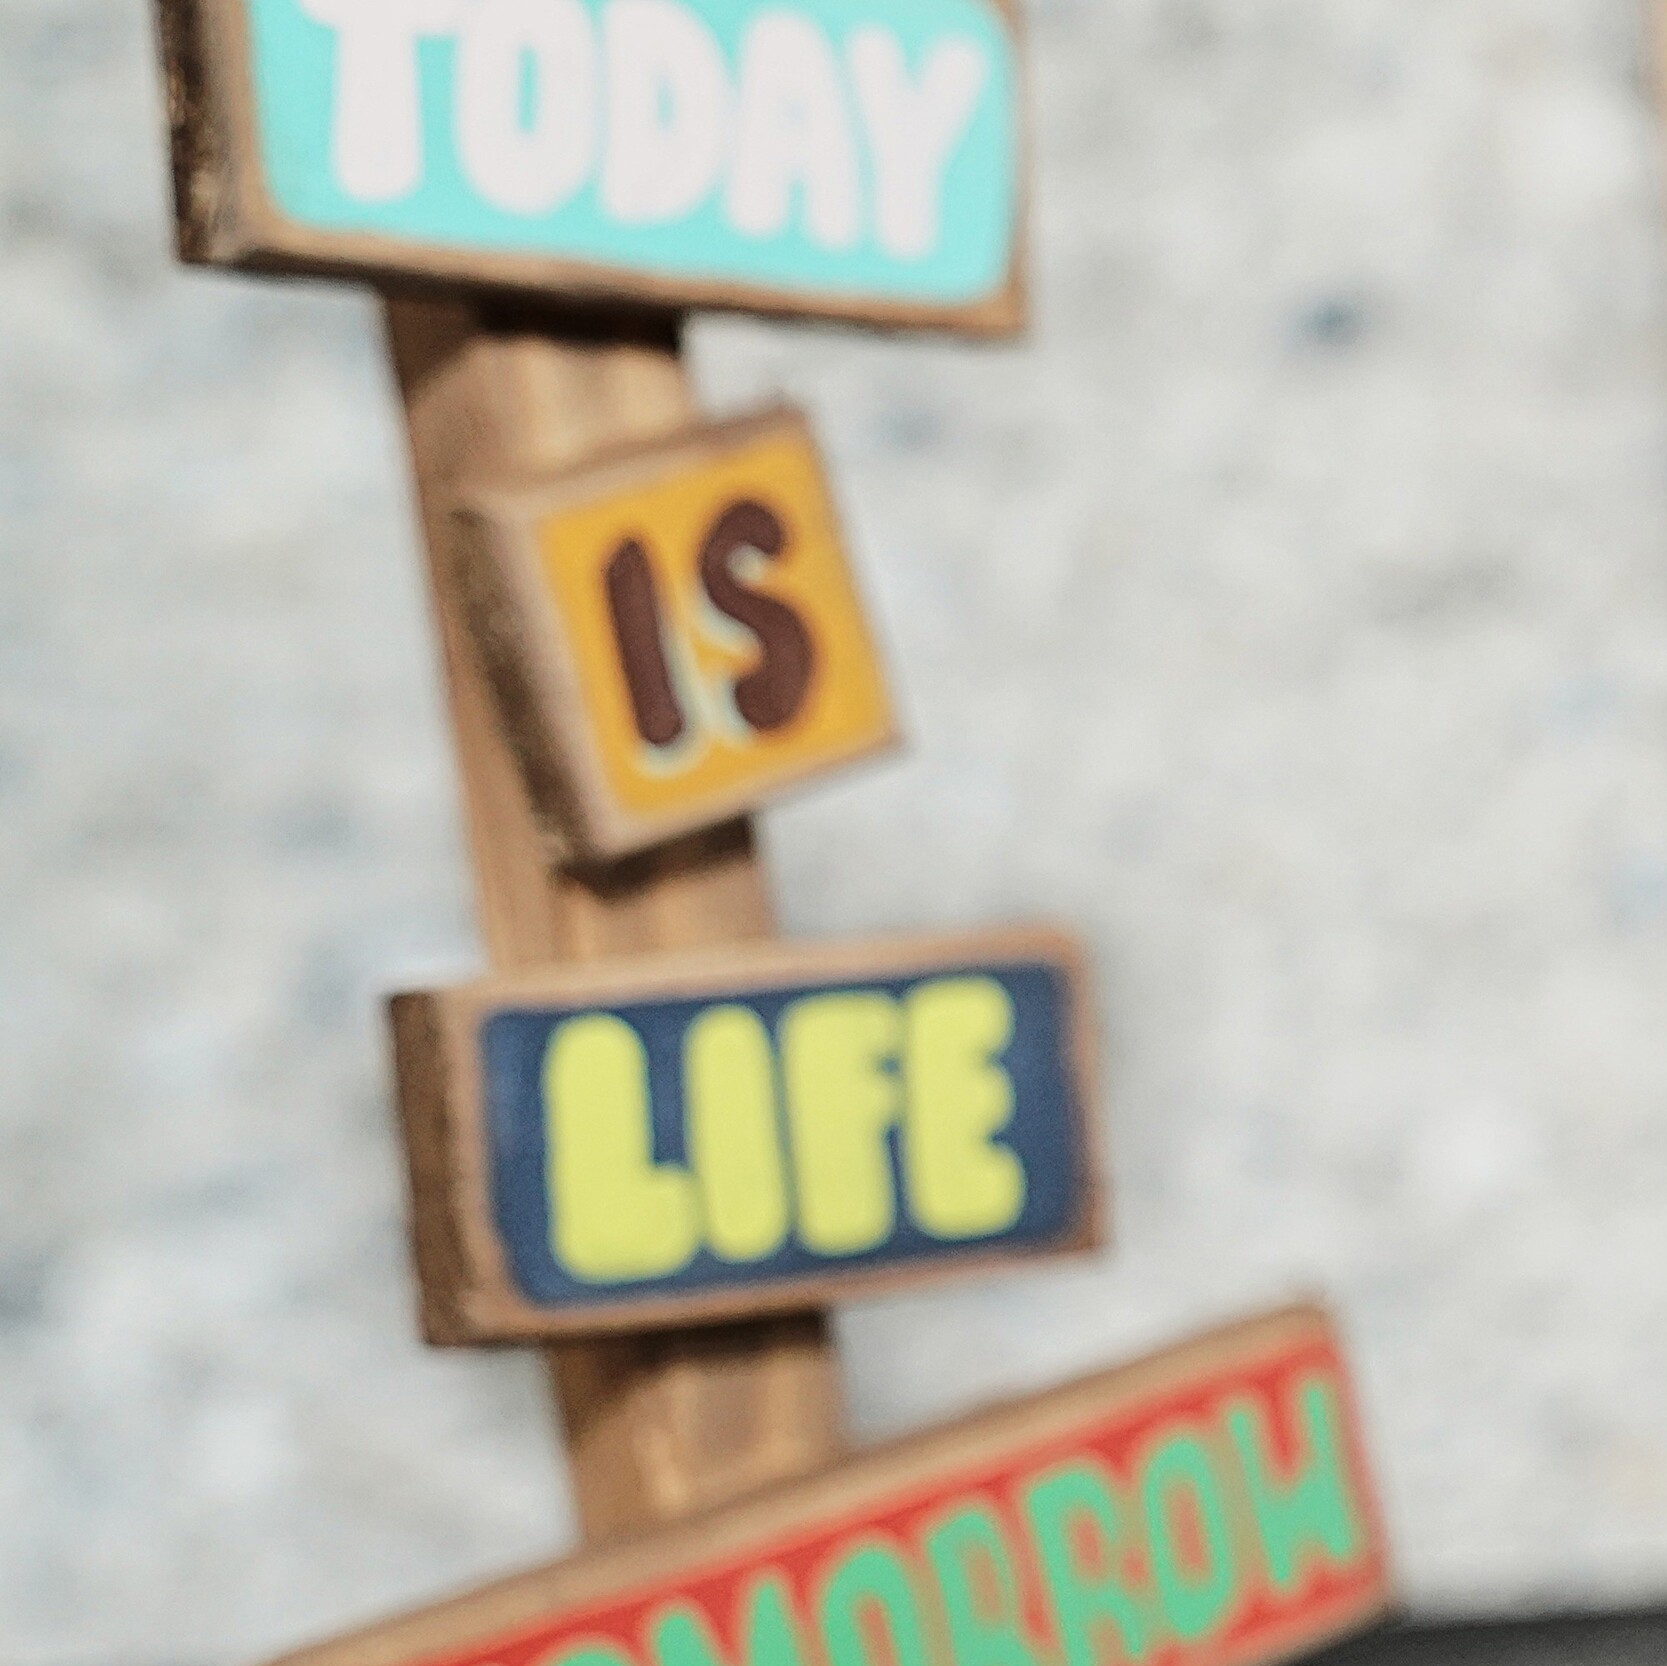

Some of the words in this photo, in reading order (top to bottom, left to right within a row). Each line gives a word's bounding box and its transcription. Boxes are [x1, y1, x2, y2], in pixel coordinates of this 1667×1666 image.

[302, 0, 985, 259] TODAY
[605, 500, 815, 747] IS
[542, 976, 1026, 1283] LIFE
